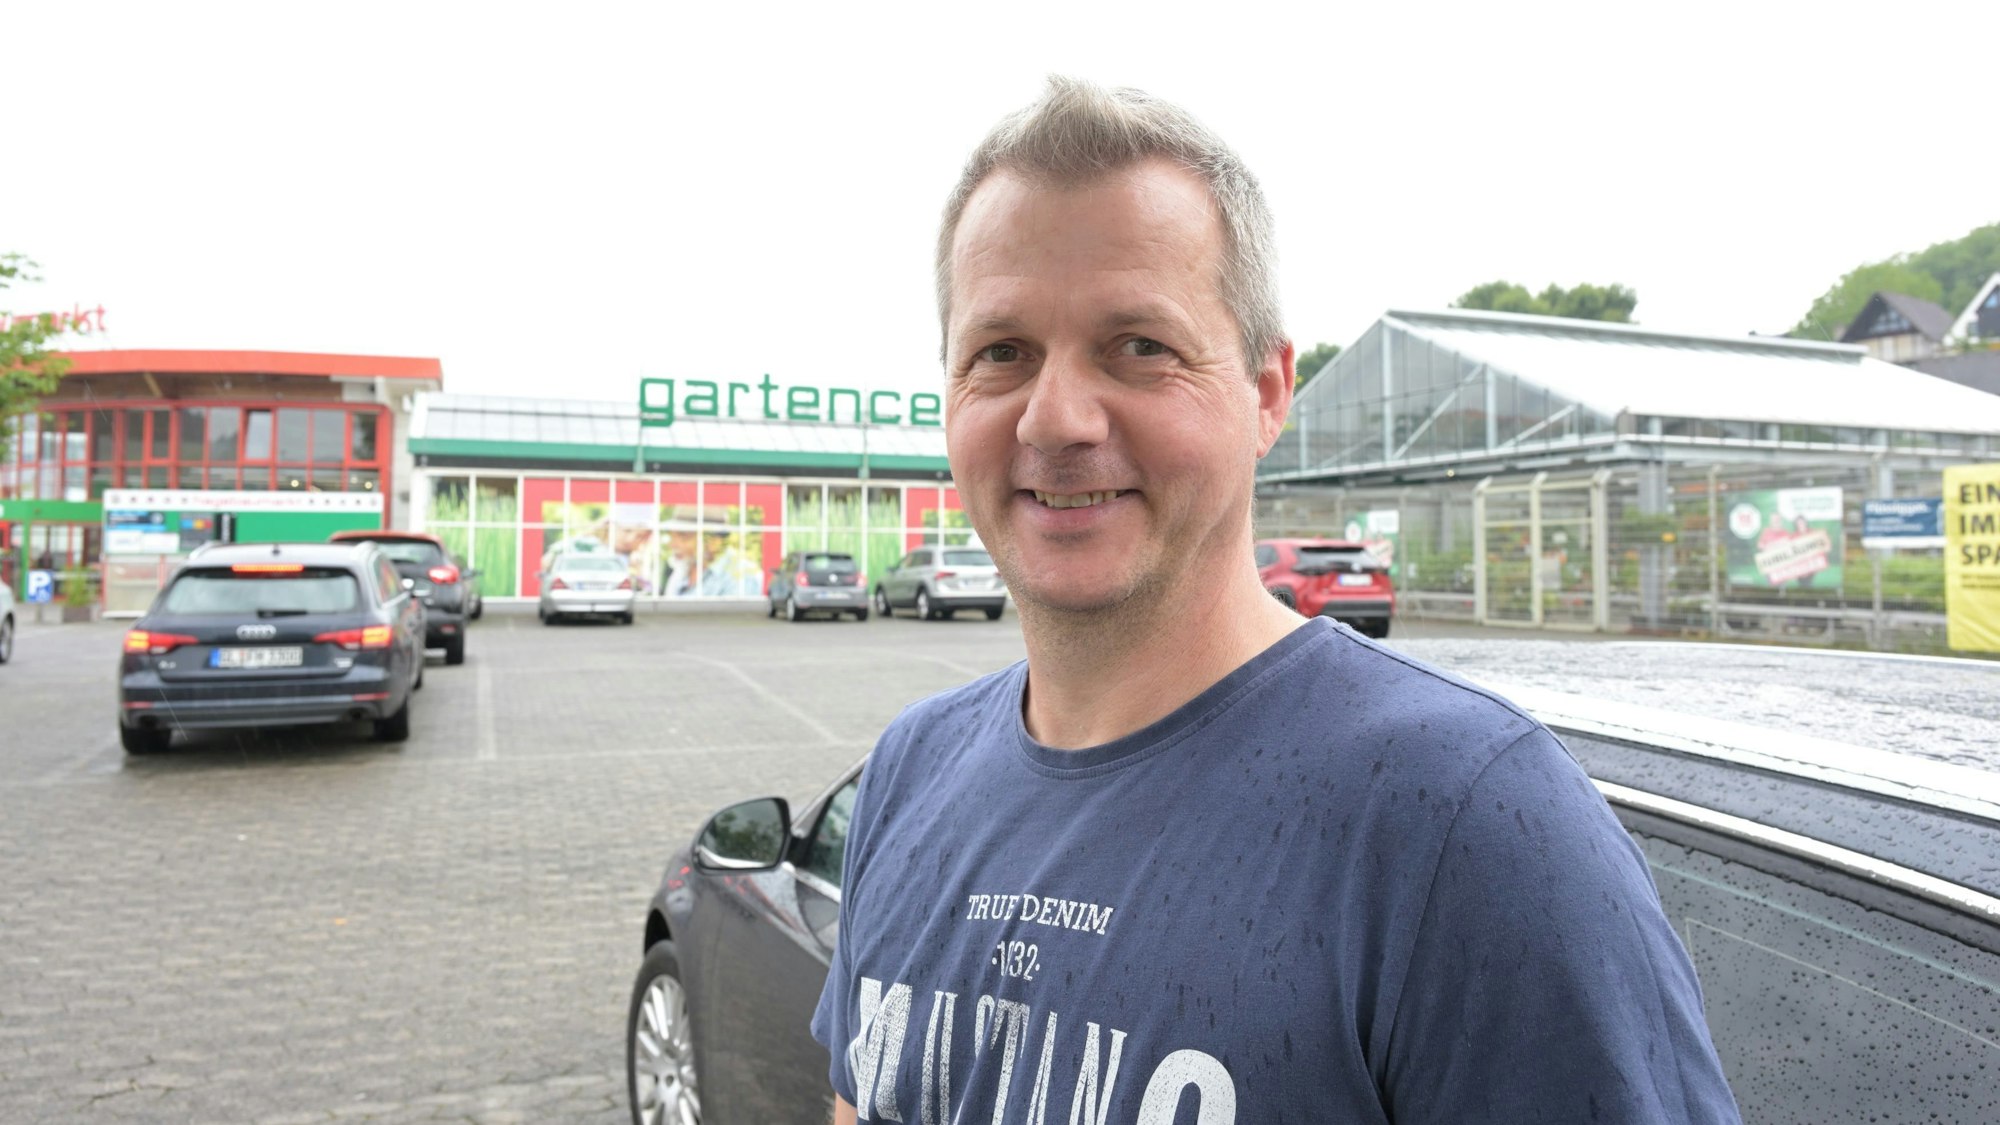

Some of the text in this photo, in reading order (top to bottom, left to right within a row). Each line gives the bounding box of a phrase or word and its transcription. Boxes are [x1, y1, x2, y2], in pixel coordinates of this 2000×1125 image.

[639, 373, 941, 427] gartence
[1960, 514, 2000, 535] IM
[28, 571, 51, 596] P
[966, 893, 1114, 935] TRUE DENIM
